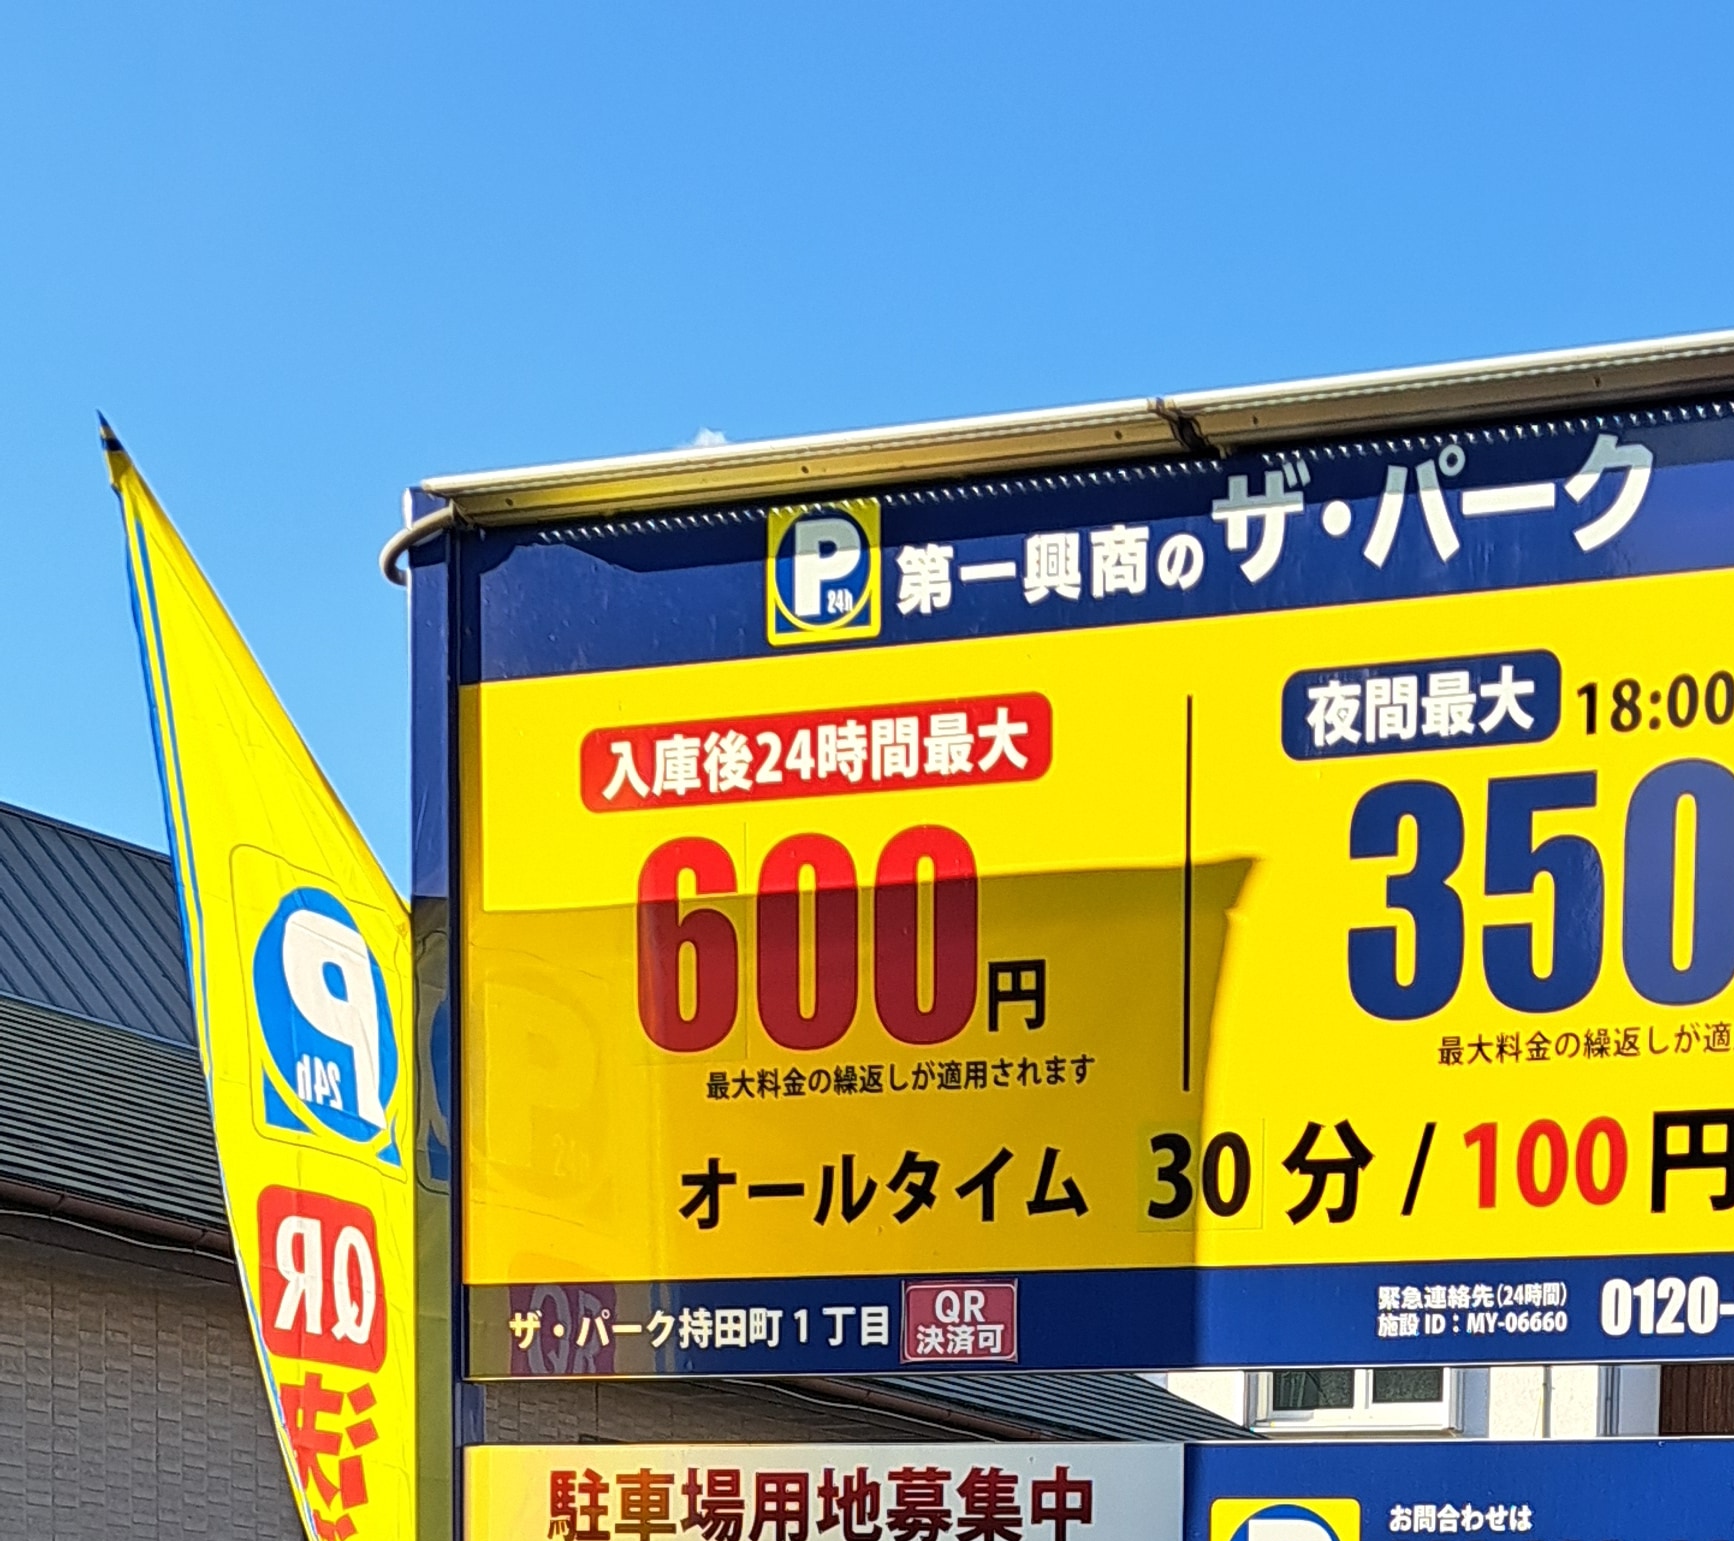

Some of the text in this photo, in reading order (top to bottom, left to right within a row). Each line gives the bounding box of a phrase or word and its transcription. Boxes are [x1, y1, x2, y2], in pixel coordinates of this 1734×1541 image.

[795, 517, 861, 617] P
[827, 588, 853, 614] 24h
[1306, 664, 1536, 748] 夜間最大
[602, 708, 1029, 800] 入庫後24時間最大
[705, 1054, 1096, 1101] 最大料金の繰返しが適用されます
[678, 1146, 1089, 1231] オールタイム
[935, 1289, 985, 1323] QR
[916, 1324, 1005, 1354] 決済可
[1389, 1503, 1533, 1533] お問合わせは
